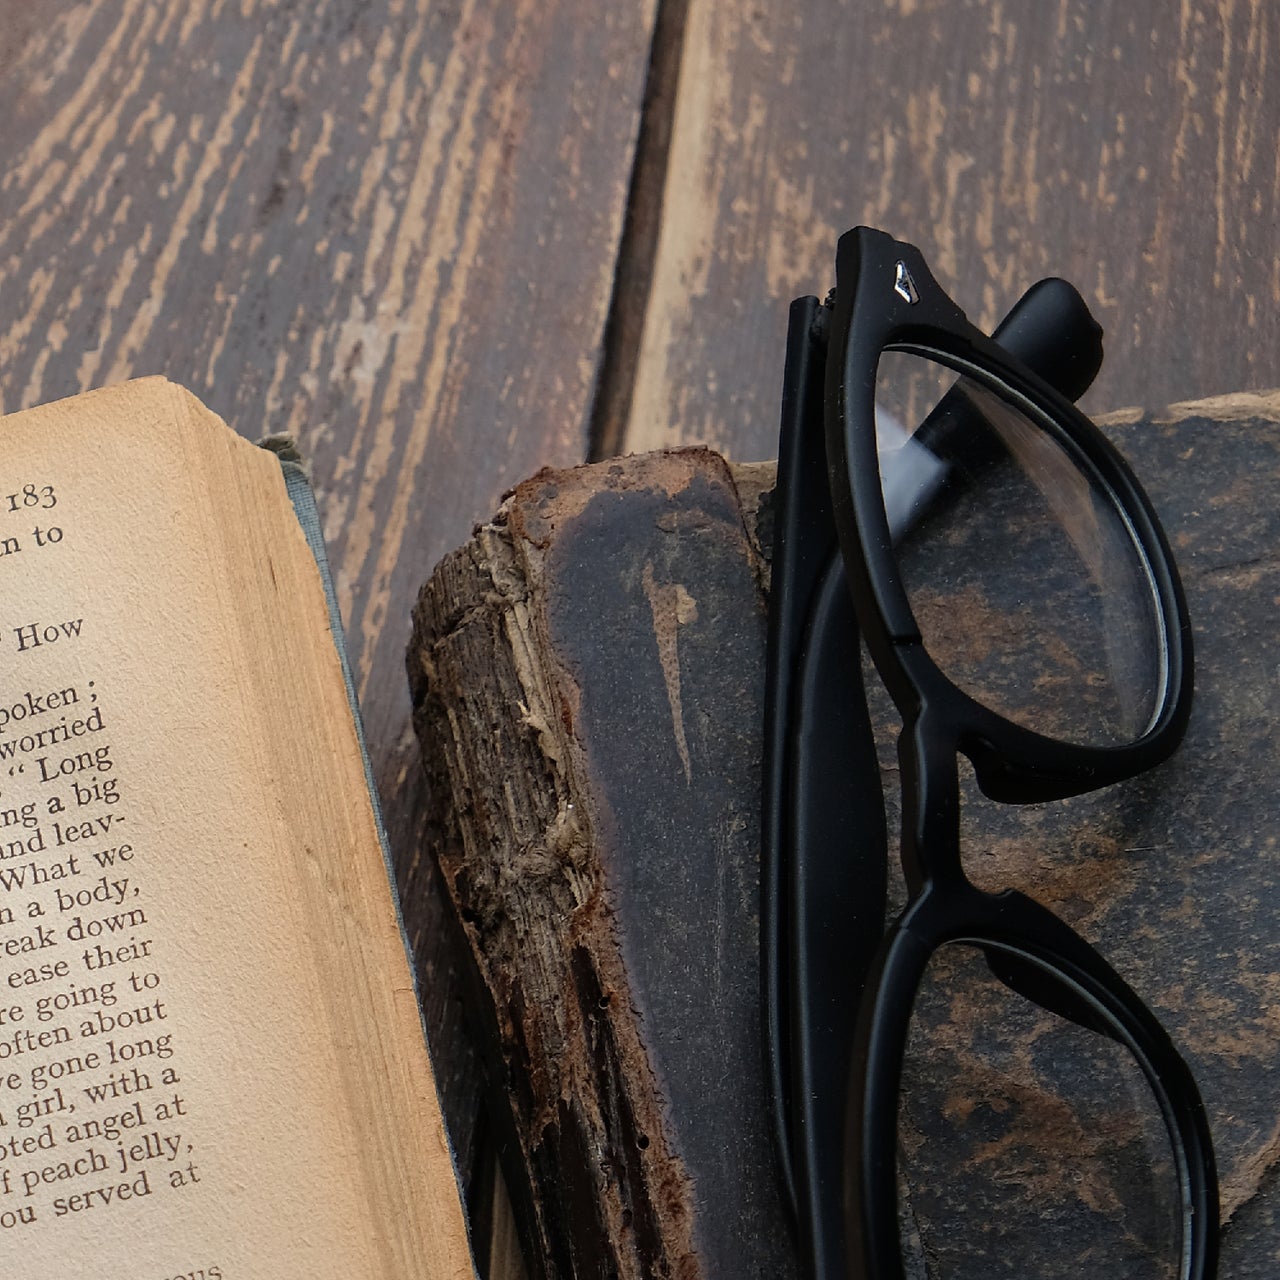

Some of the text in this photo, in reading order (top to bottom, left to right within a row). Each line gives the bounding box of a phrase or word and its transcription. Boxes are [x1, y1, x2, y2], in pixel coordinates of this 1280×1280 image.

[4, 482, 59, 514] 183
[30, 524, 65, 548] to
[91, 842, 136, 870] we
[6, 959, 72, 990] ease
[80, 938, 154, 972] their
[19, 1146, 112, 1199] peach
[115, 1130, 195, 1175] jelly,
